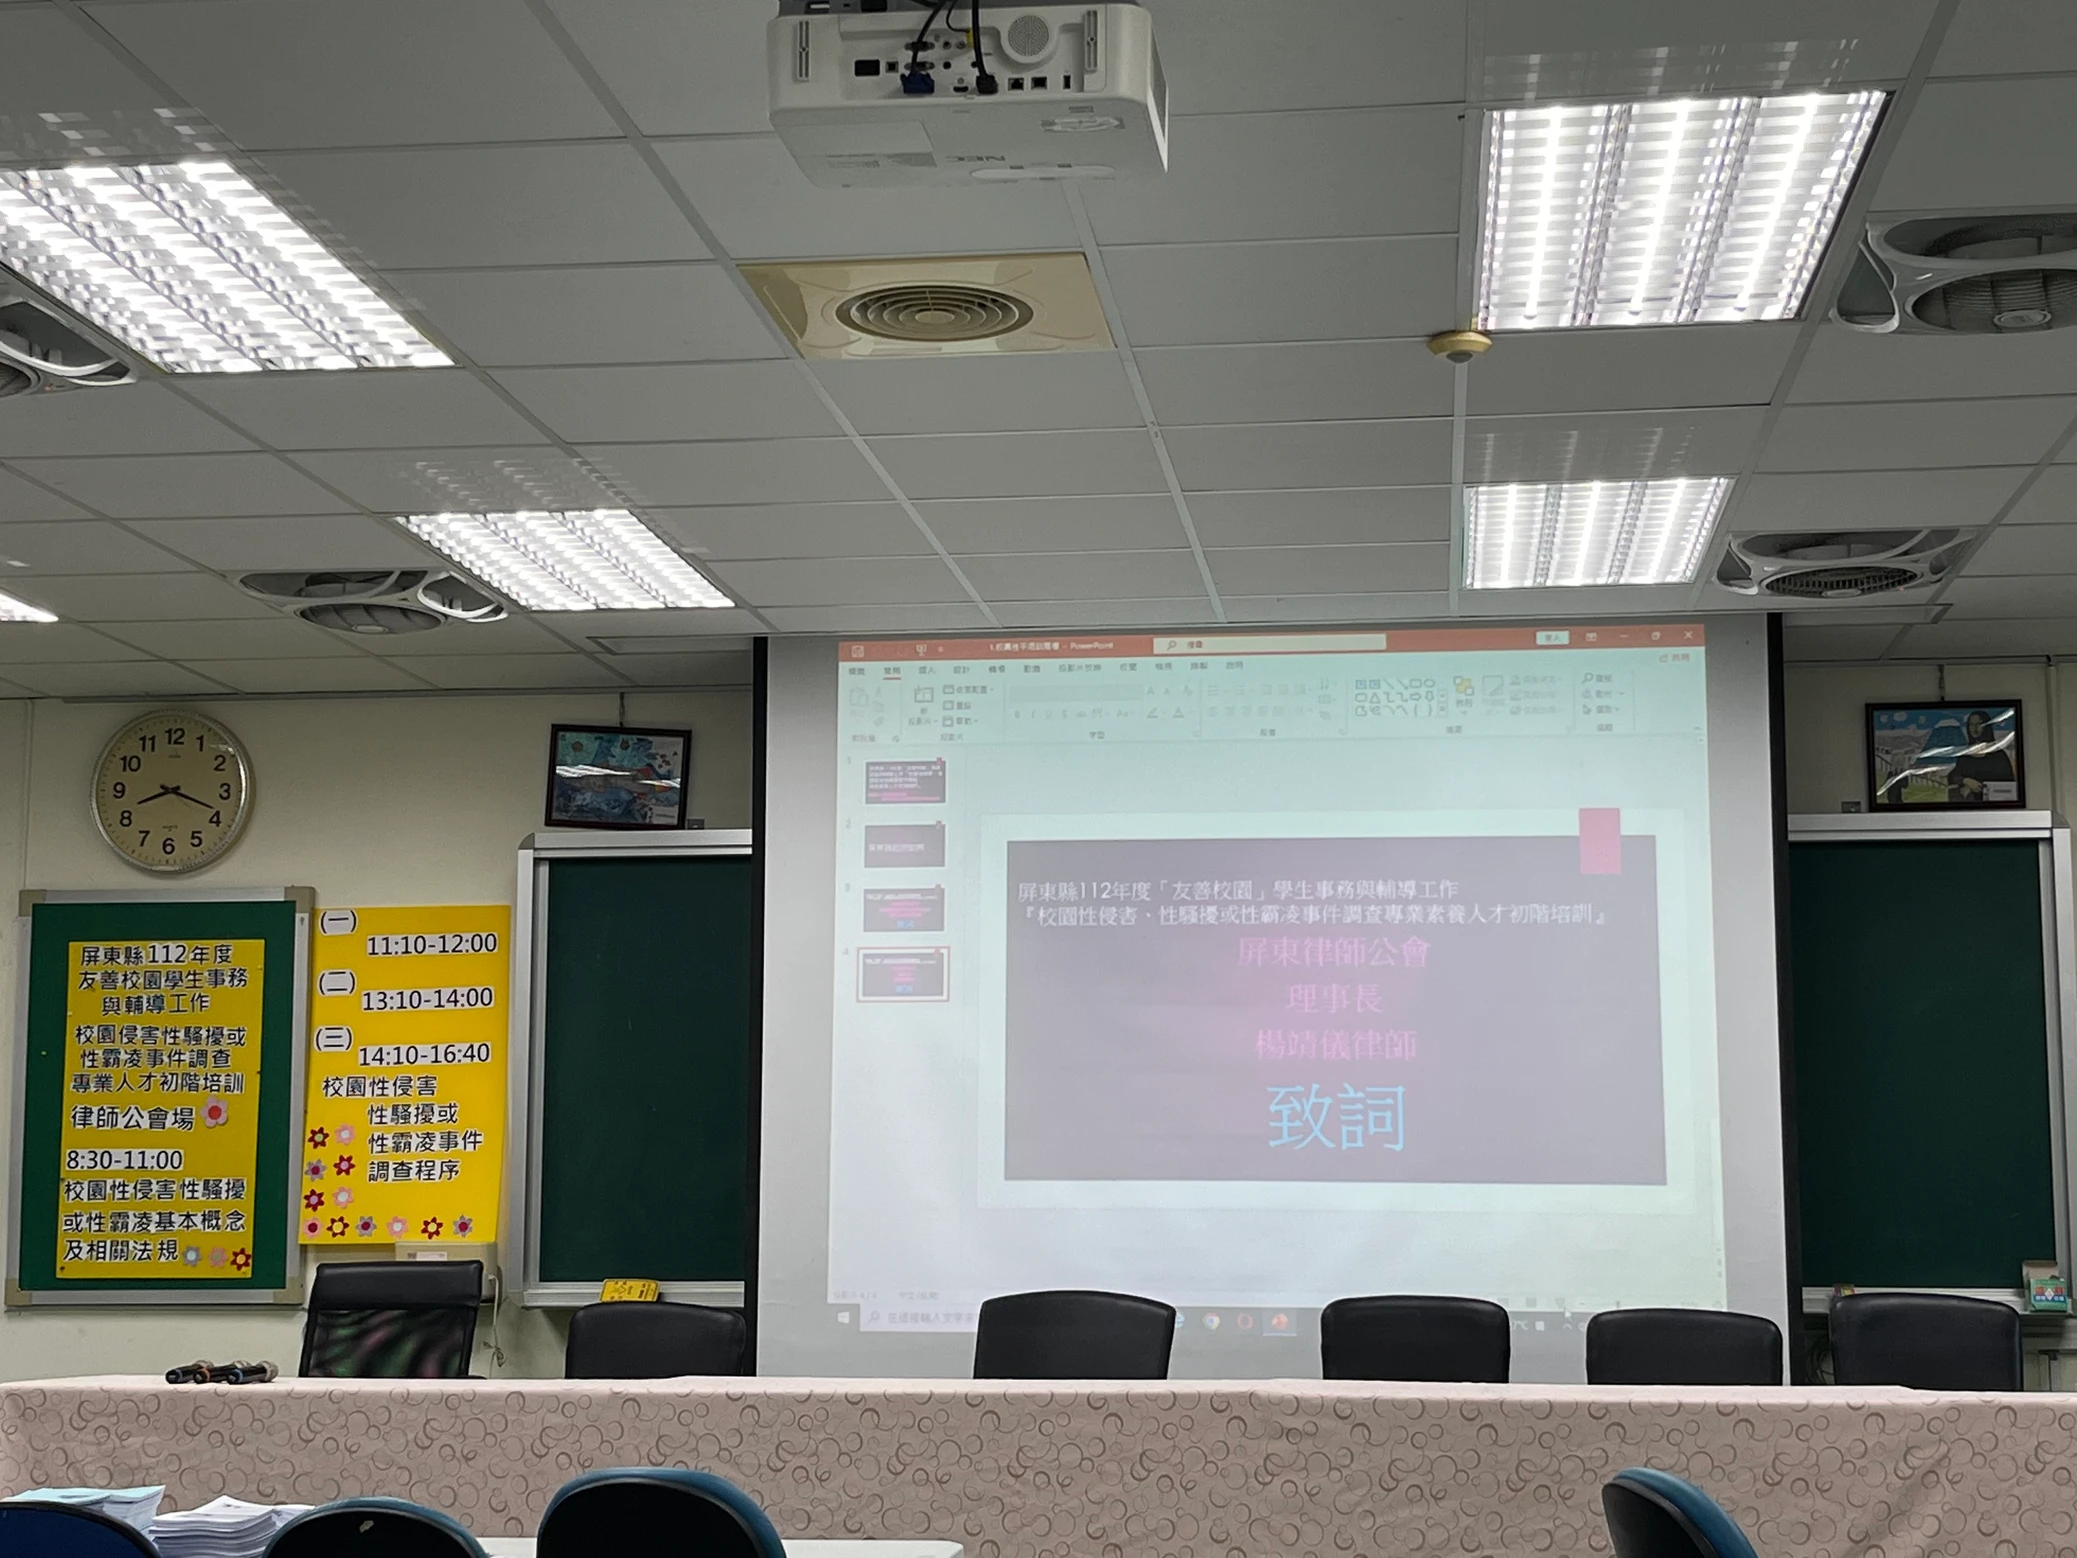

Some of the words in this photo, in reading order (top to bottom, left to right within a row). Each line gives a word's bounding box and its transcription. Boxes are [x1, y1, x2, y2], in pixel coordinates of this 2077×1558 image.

[138, 735, 157, 753] 11
[165, 727, 186, 746] 12
[196, 735, 205, 752] 1
[120, 755, 142, 772] 10
[213, 754, 227, 772] 2
[112, 781, 126, 799] 9
[218, 782, 231, 801] 3
[119, 810, 133, 827] 8
[208, 810, 222, 827] 4
[138, 830, 151, 847] 7
[162, 837, 176, 855] 6
[190, 830, 203, 848] 5
[80, 944, 233, 967] 屏東縣112年度
[367, 932, 498, 956] 11:10-12:00
[1237, 934, 1432, 968] 屏東律師公會
[78, 967, 248, 991] 友善校園學生事務
[101, 992, 211, 1016] 與輔導工作
[362, 987, 493, 1011] 13:10-14:00
[1286, 983, 1384, 1014] 理事長
[75, 1024, 247, 1046] 校園侵害性騷擾或
[1255, 1028, 1418, 1061] 楊靖儀律師
[80, 1048, 232, 1069] 性霸凌事件調查
[358, 1043, 491, 1066] 14:10-16:40
[71, 1072, 245, 1094] 專業人才初階培訓
[322, 1075, 438, 1098] 校園性侵害
[70, 1104, 195, 1131] 律師公會場
[367, 1102, 459, 1126] 性騷擾或
[1266, 1082, 1406, 1152] 致詞
[368, 1130, 483, 1154] 性霸凌事件
[66, 1150, 183, 1170] 8:30-11:00
[368, 1159, 461, 1183] 調查程序
[64, 1178, 246, 1201] 校園性侵害性騷擾
[63, 1209, 246, 1233] 或性霸凌基本概念
[63, 1239, 179, 1262] 及相關法規
